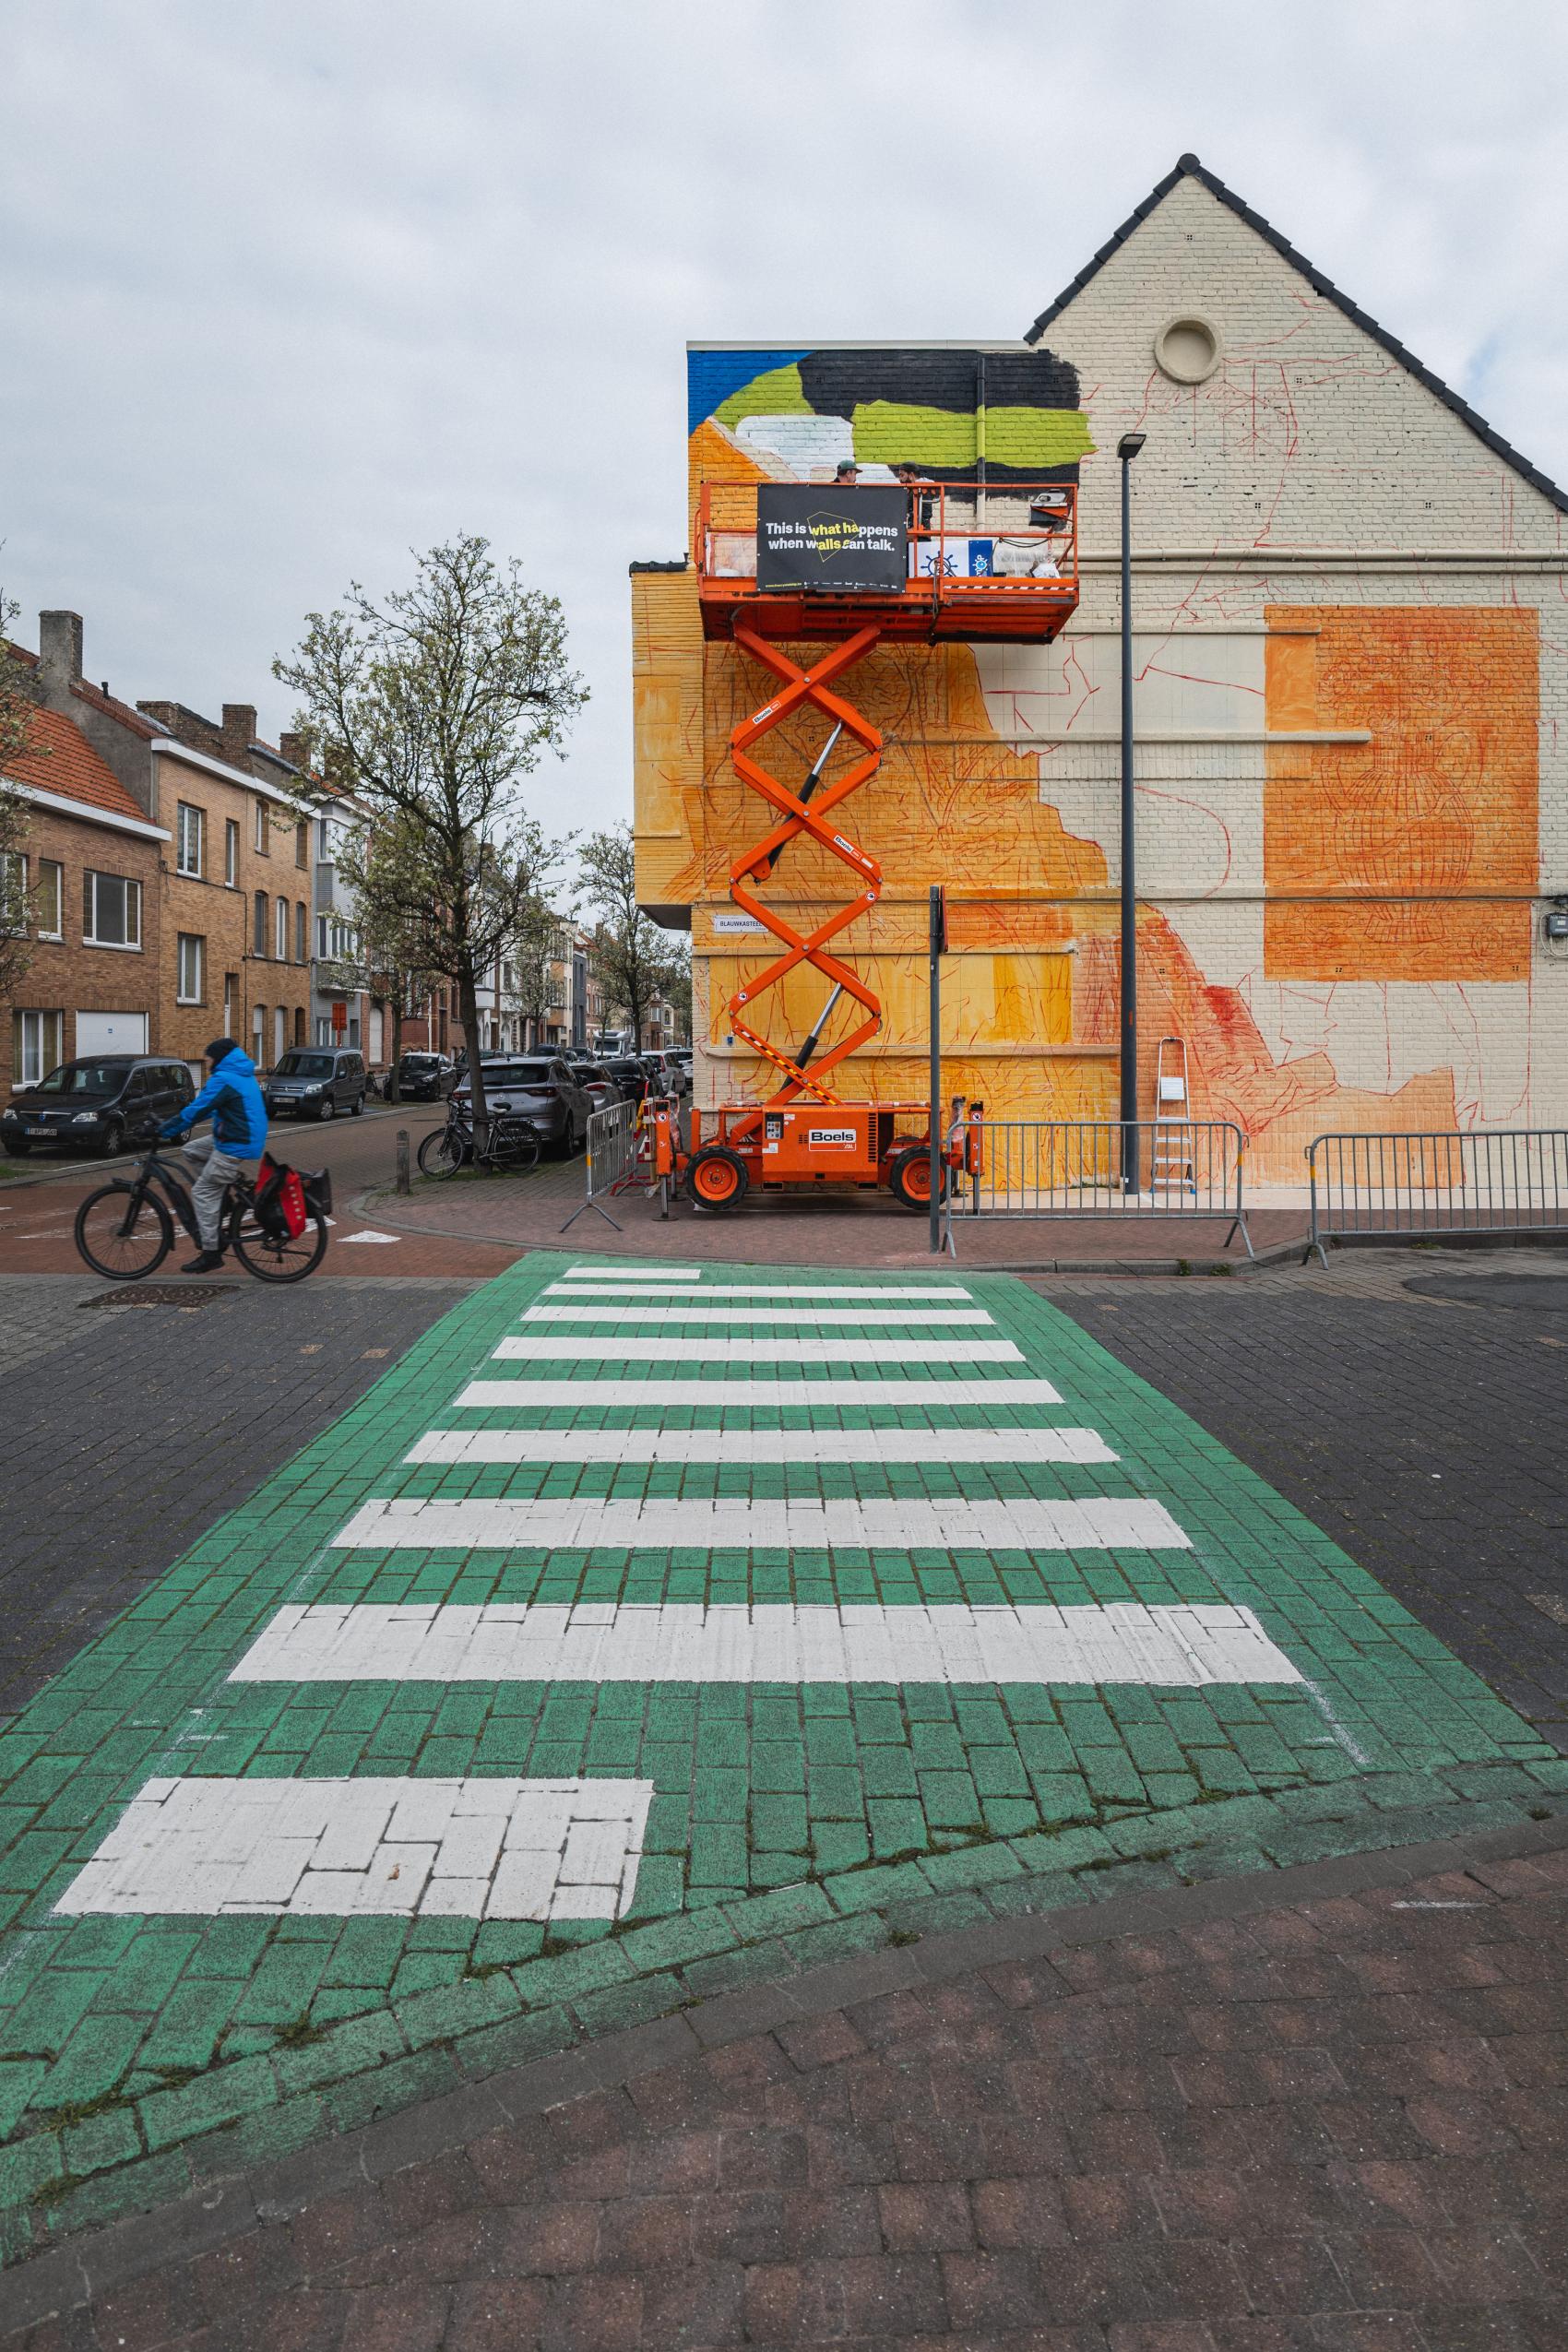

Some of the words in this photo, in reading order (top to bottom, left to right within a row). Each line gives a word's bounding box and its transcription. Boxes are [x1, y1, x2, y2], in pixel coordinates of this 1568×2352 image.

[766, 522, 793, 535] This
[795, 522, 807, 534] is
[808, 523, 841, 536] what
[843, 522, 898, 538] happens
[768, 538, 803, 550] when
[806, 539, 841, 551] walls
[842, 539, 865, 550] can
[867, 539, 896, 552] talk.
[811, 1132, 854, 1142] Boels
